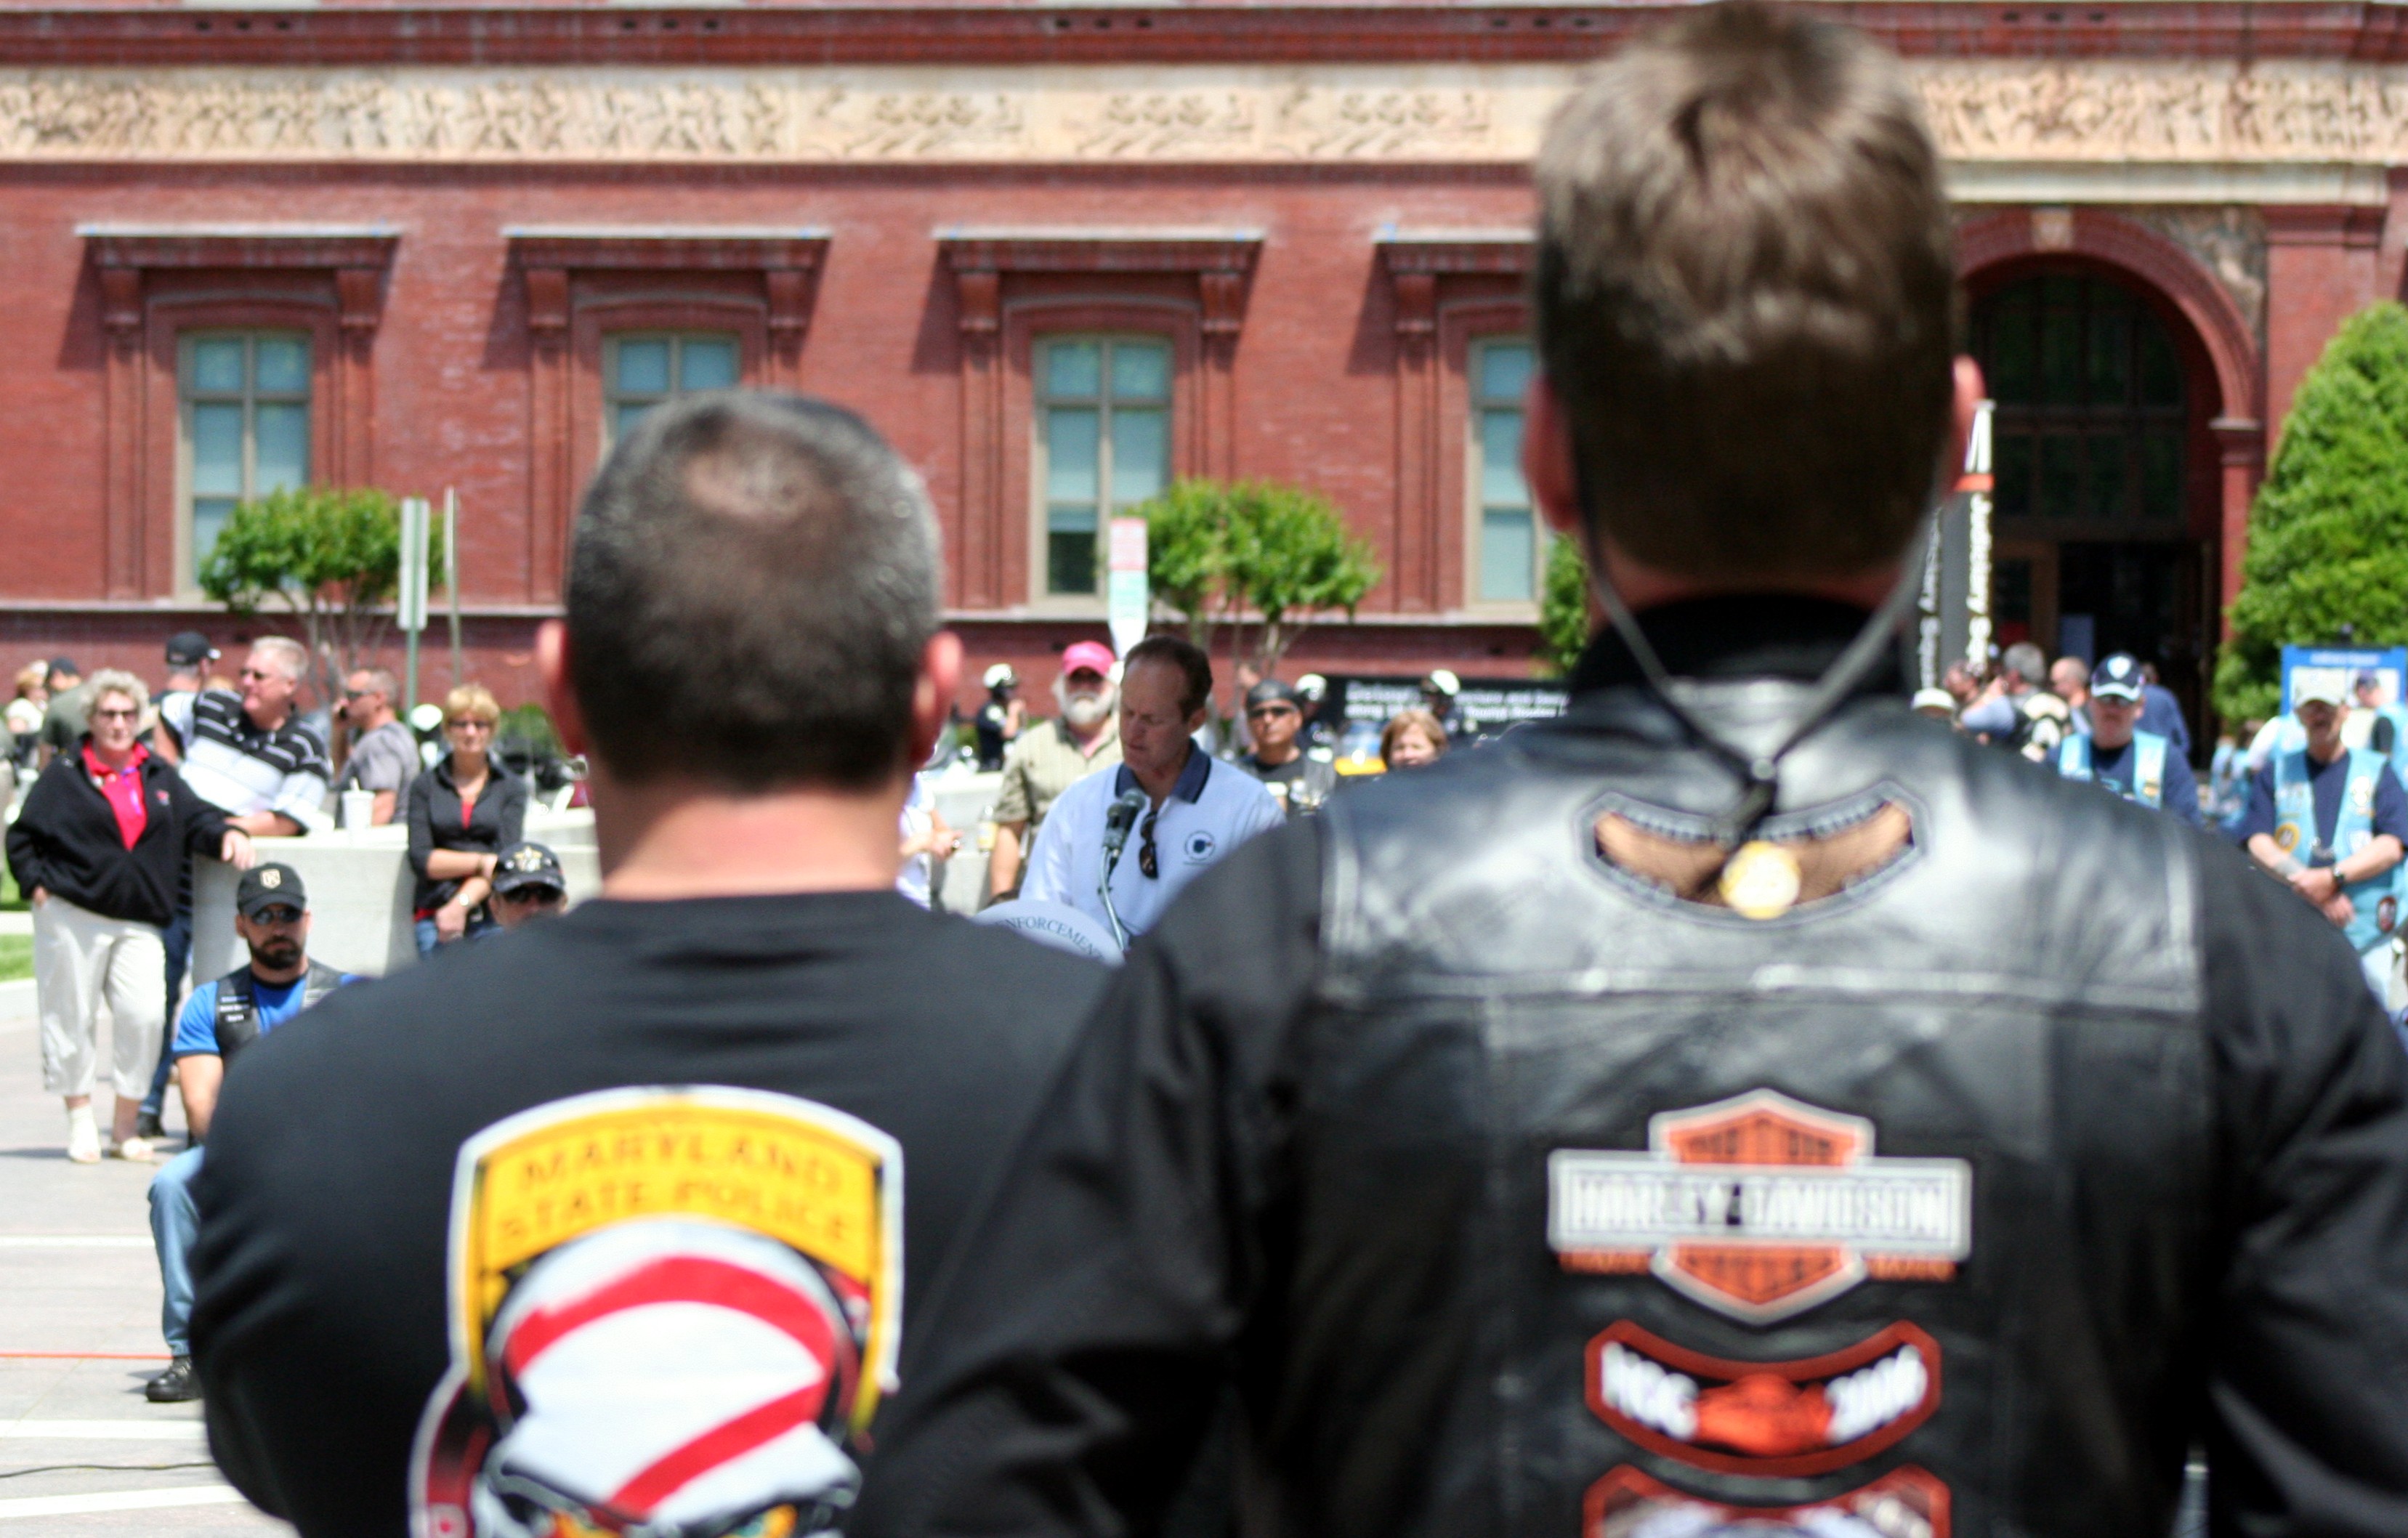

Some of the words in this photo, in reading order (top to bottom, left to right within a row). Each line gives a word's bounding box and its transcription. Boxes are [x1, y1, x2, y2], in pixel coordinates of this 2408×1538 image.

[520, 1130, 846, 1191] MARYLAND
[497, 1180, 648, 1241] STATE
[673, 1180, 850, 1241] POLICE
